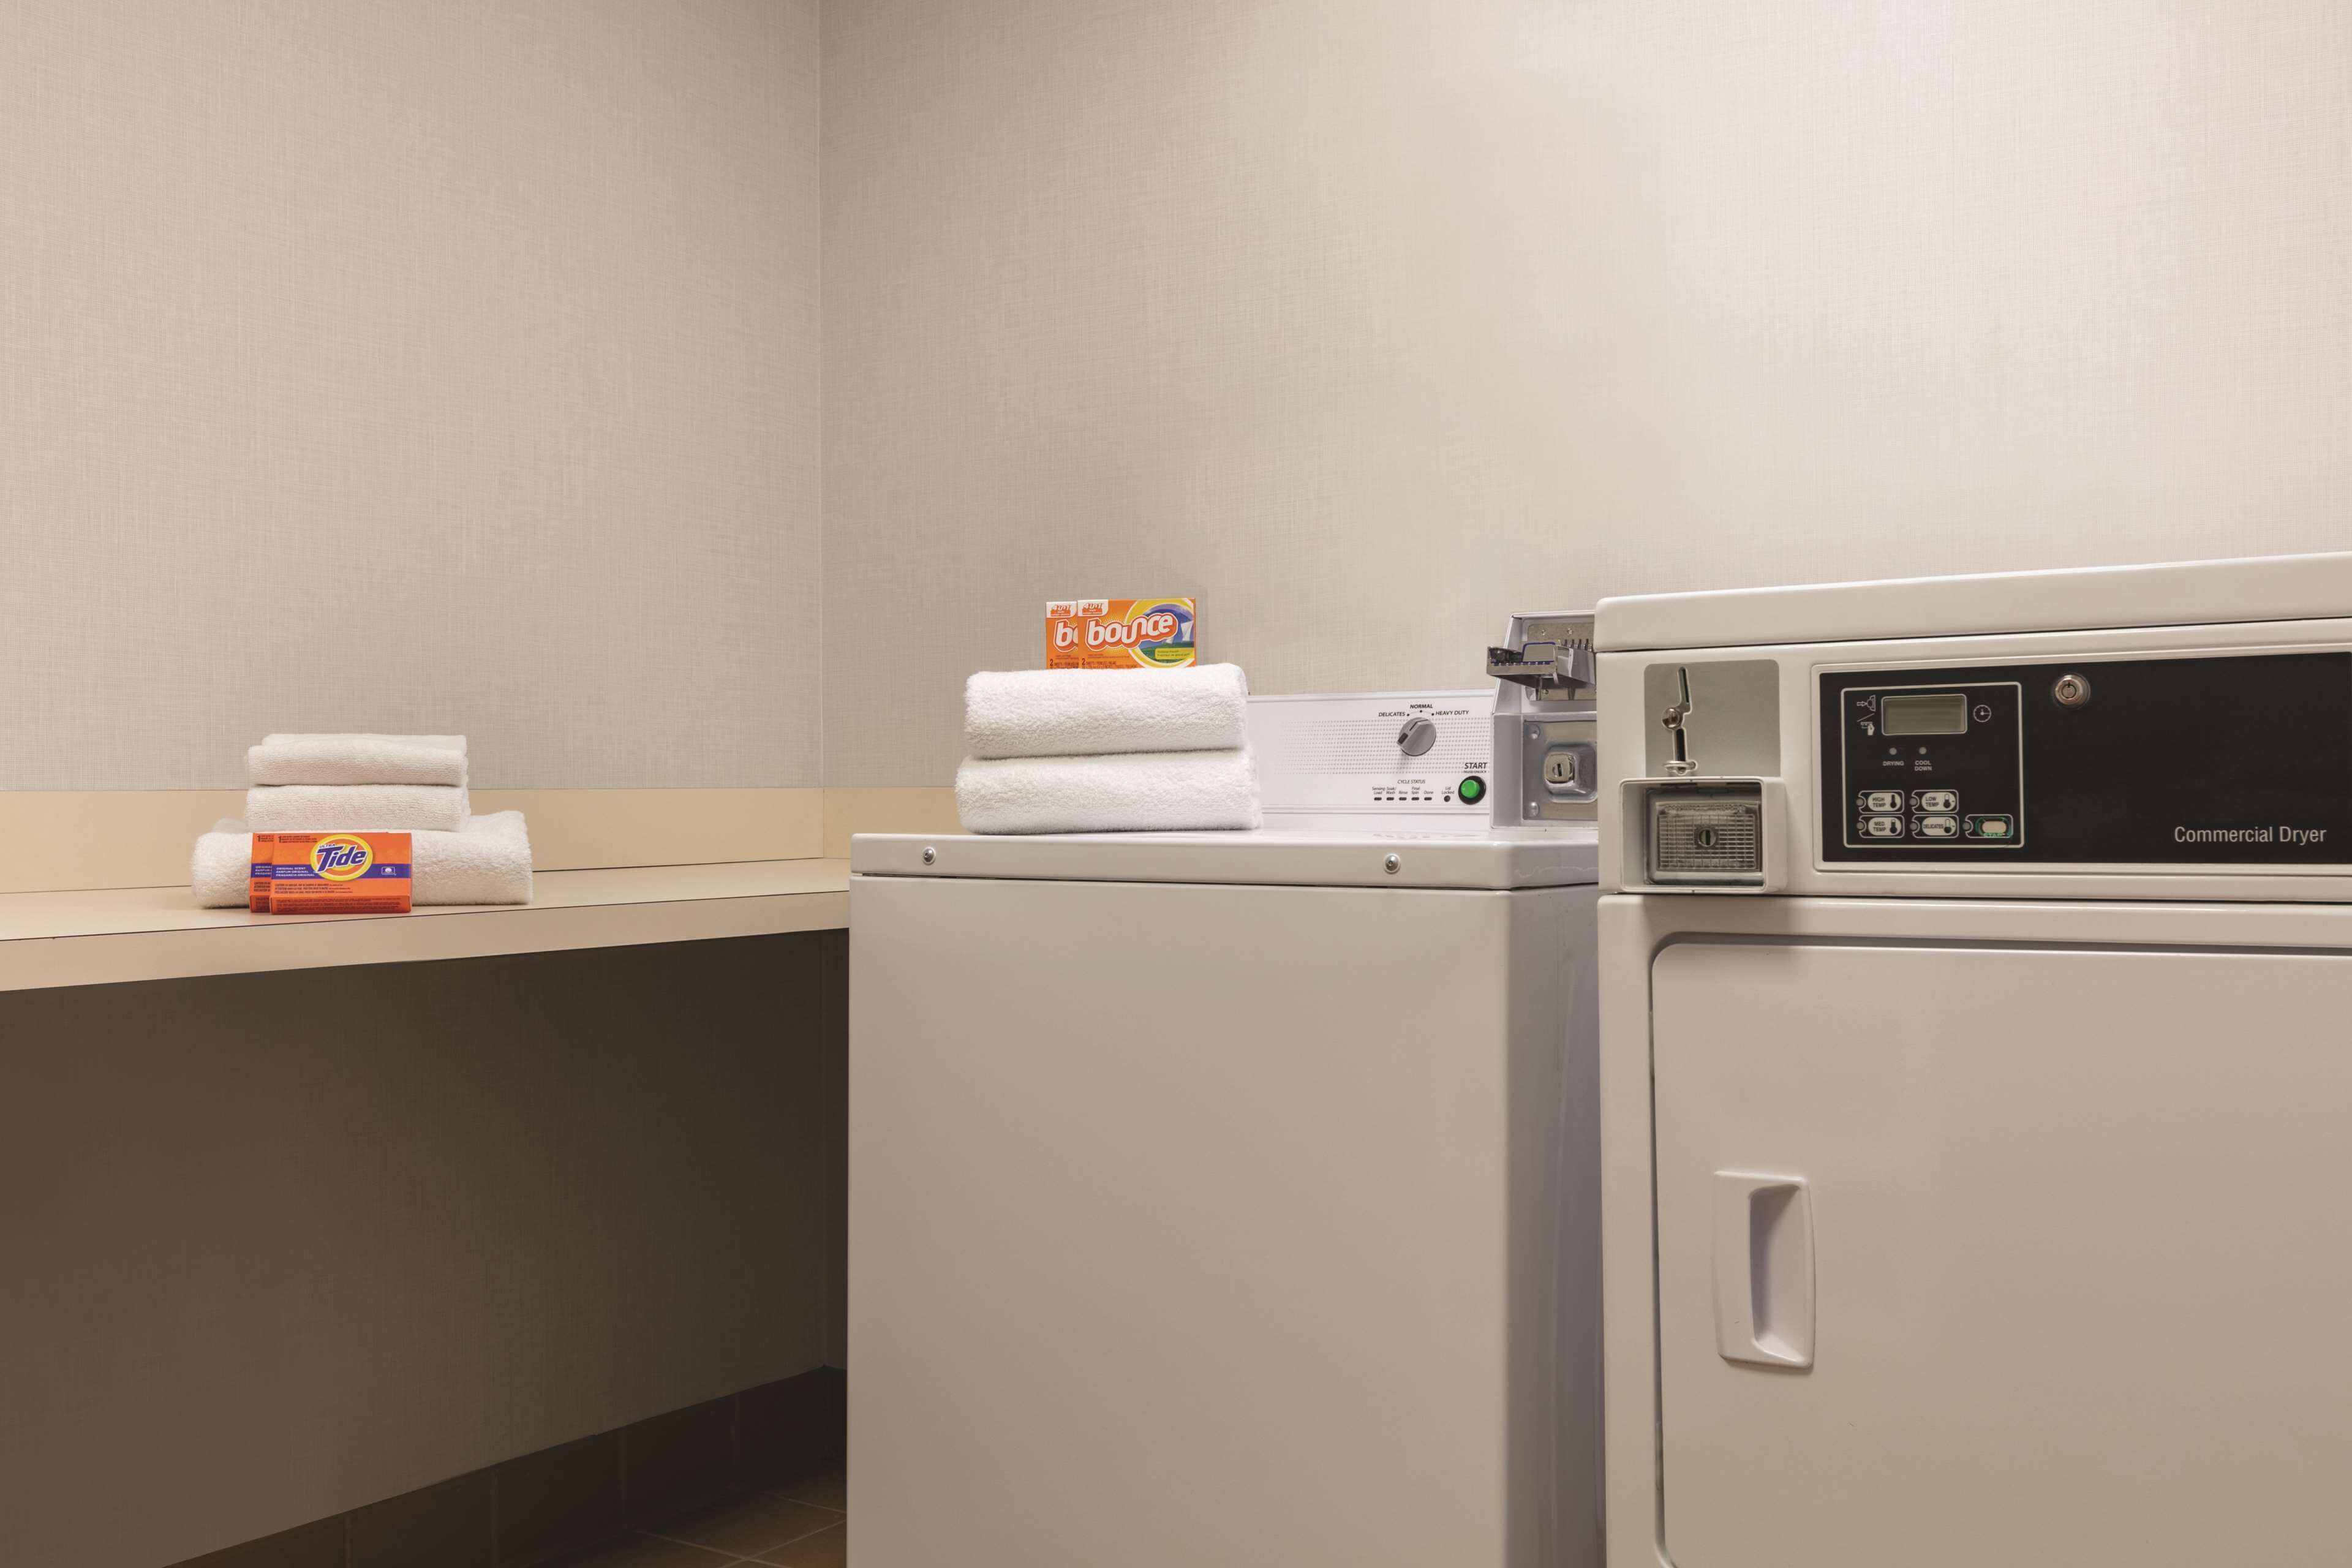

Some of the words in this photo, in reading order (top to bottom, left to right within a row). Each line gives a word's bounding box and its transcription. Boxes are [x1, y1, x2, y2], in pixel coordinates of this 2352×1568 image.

[1087, 614, 1174, 646] bounce
[2174, 826, 2273, 842] Commercial
[2278, 826, 2327, 845] Dryer
[316, 845, 368, 872] Tide
